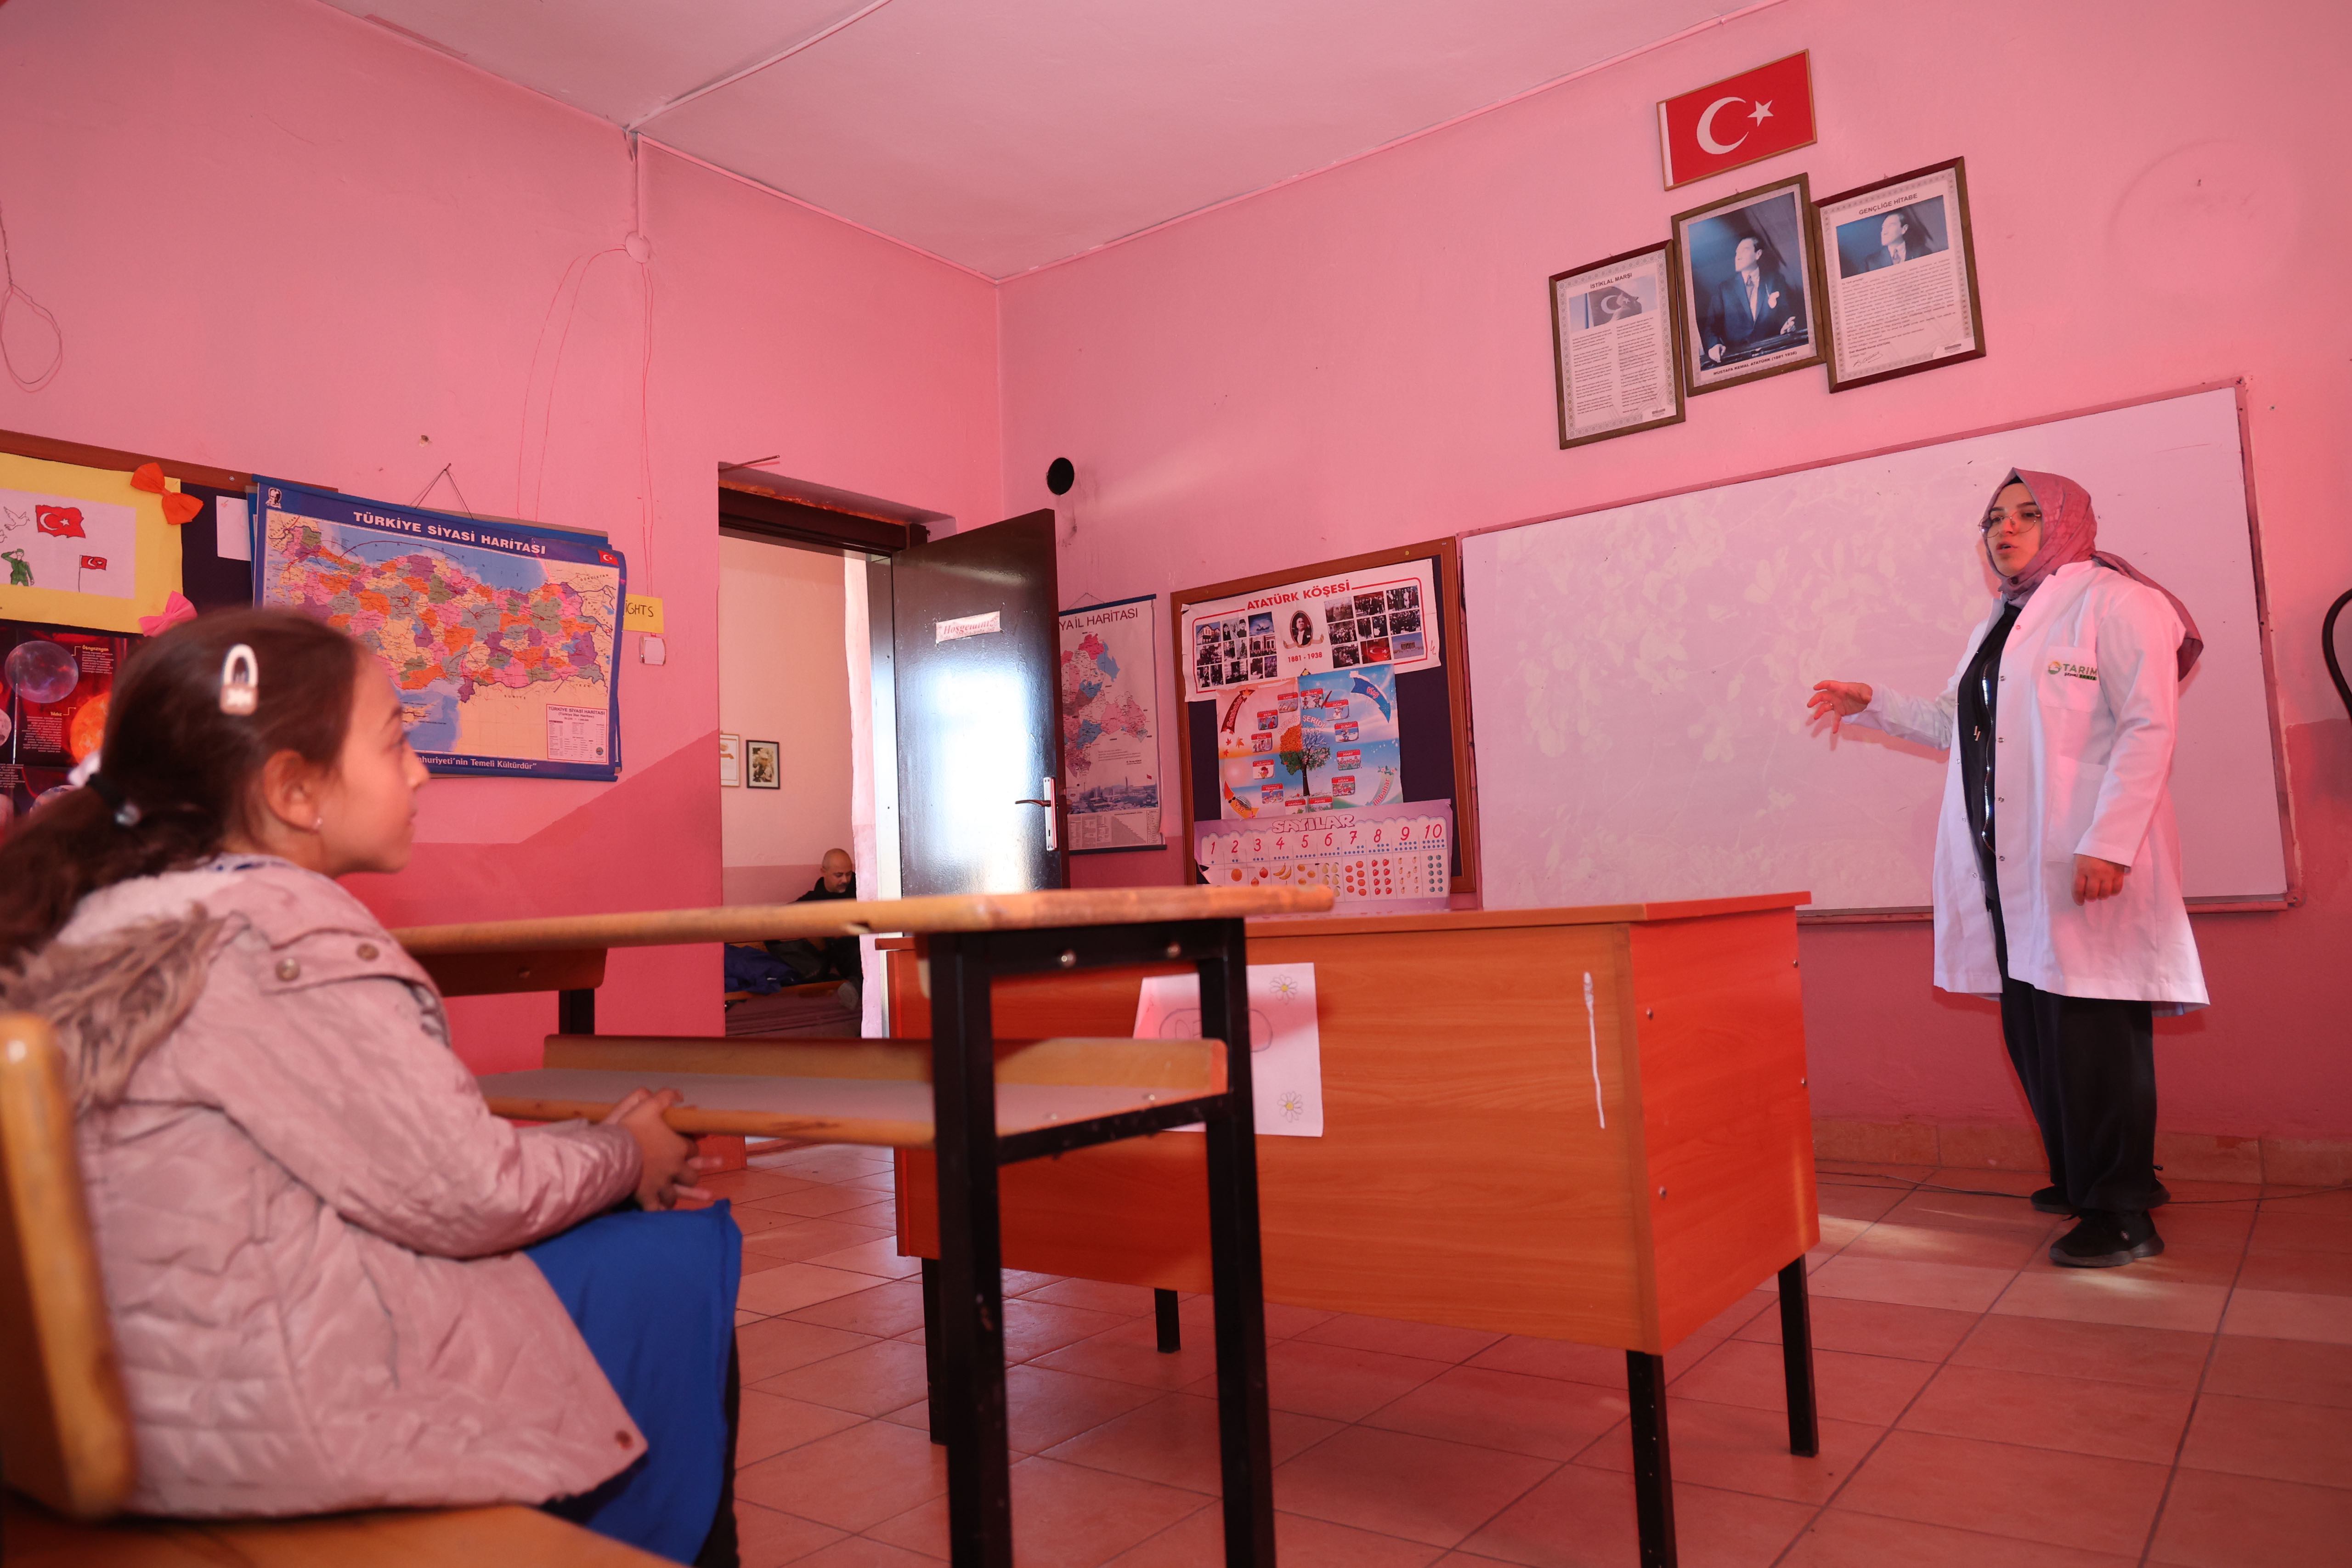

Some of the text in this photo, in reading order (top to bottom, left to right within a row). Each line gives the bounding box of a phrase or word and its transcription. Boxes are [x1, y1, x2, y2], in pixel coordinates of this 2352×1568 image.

[1859, 193, 1917, 215] GENÇLİĞE HİTABE
[1590, 272, 1632, 289] İSTİKLAL MARŞI
[1713, 367, 1733, 375] MUSTAFA
[1750, 357, 1771, 366] ATATÜRK
[353, 511, 546, 555] TÜRKİYE SİYASİ HARİTASI
[1247, 579, 1350, 610] ATATÜRK KÖŞESİ
[625, 600, 654, 617] iGHTS
[1075, 616, 1084, 628] İL
[1086, 607, 1138, 626] HARİTASI
[1307, 651, 1323, 660] 1938
[2063, 663, 2097, 676] TARIM
[1366, 686, 1380, 699] Kış
[1227, 695, 1243, 728] Sonbahar
[1302, 715, 1327, 729] ŞERİDİ
[470, 759, 495, 767] Temeli
[1234, 801, 1245, 813] Yaz
[1272, 814, 1355, 834] SAYILAR
[1211, 823, 1442, 855] 1 2 3 4 5 6 7 8 9 10
